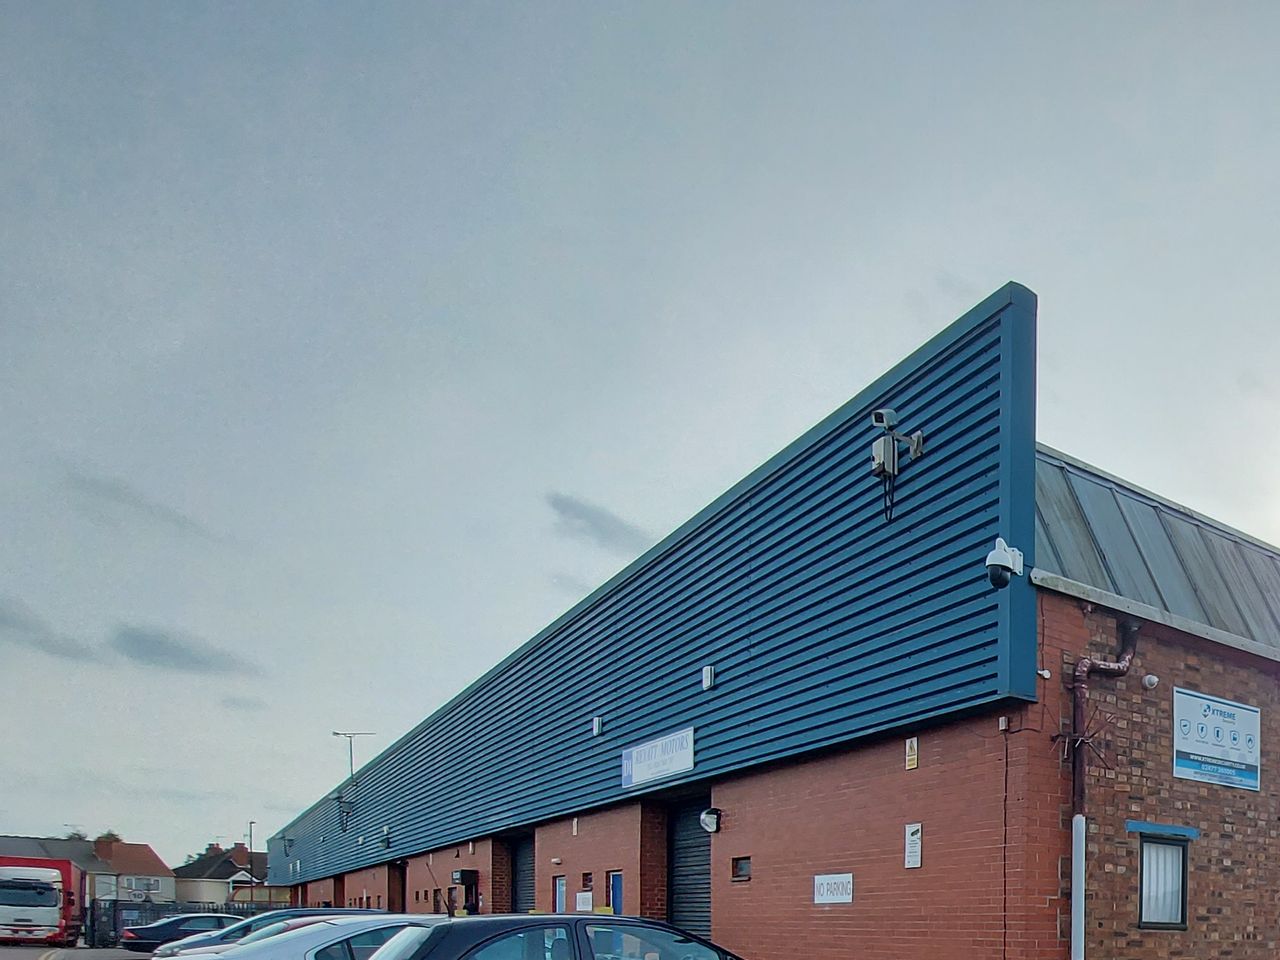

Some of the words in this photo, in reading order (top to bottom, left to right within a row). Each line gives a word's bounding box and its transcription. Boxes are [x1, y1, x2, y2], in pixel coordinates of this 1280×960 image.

[1211, 708, 1236, 721] XTREME
[661, 734, 689, 756] MOTORS
[816, 882, 825, 897] NO
[826, 880, 852, 897] PARKING
